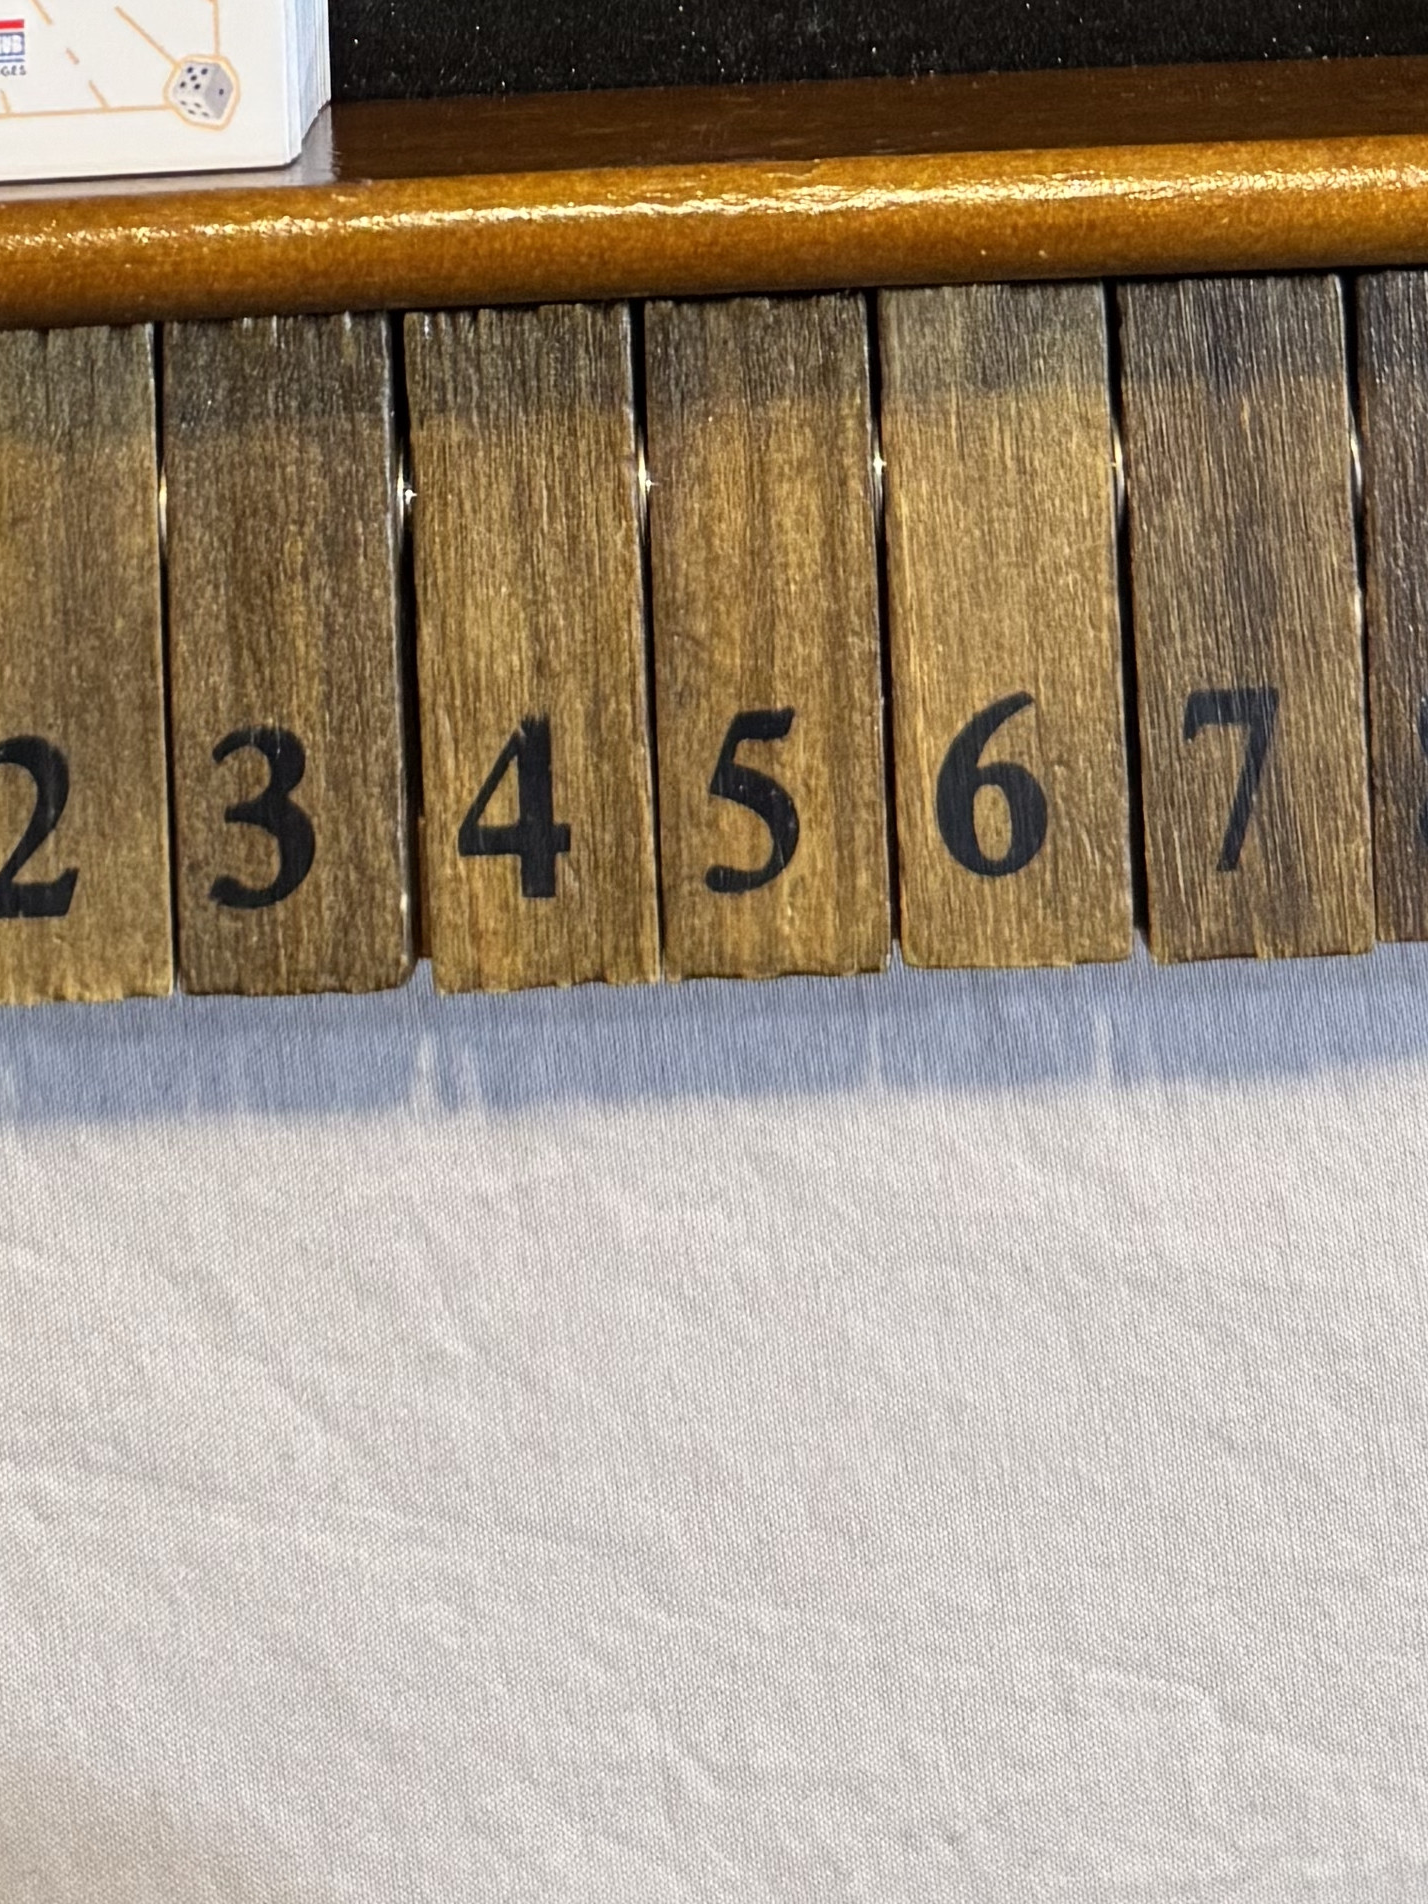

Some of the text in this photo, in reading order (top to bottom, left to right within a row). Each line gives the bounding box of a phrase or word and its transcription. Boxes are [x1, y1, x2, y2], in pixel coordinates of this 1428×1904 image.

[210, 727, 317, 910] 3
[458, 716, 571, 897] 4
[705, 708, 799, 893] 5
[937, 692, 1047, 876] 6
[1183, 688, 1279, 872] 7
